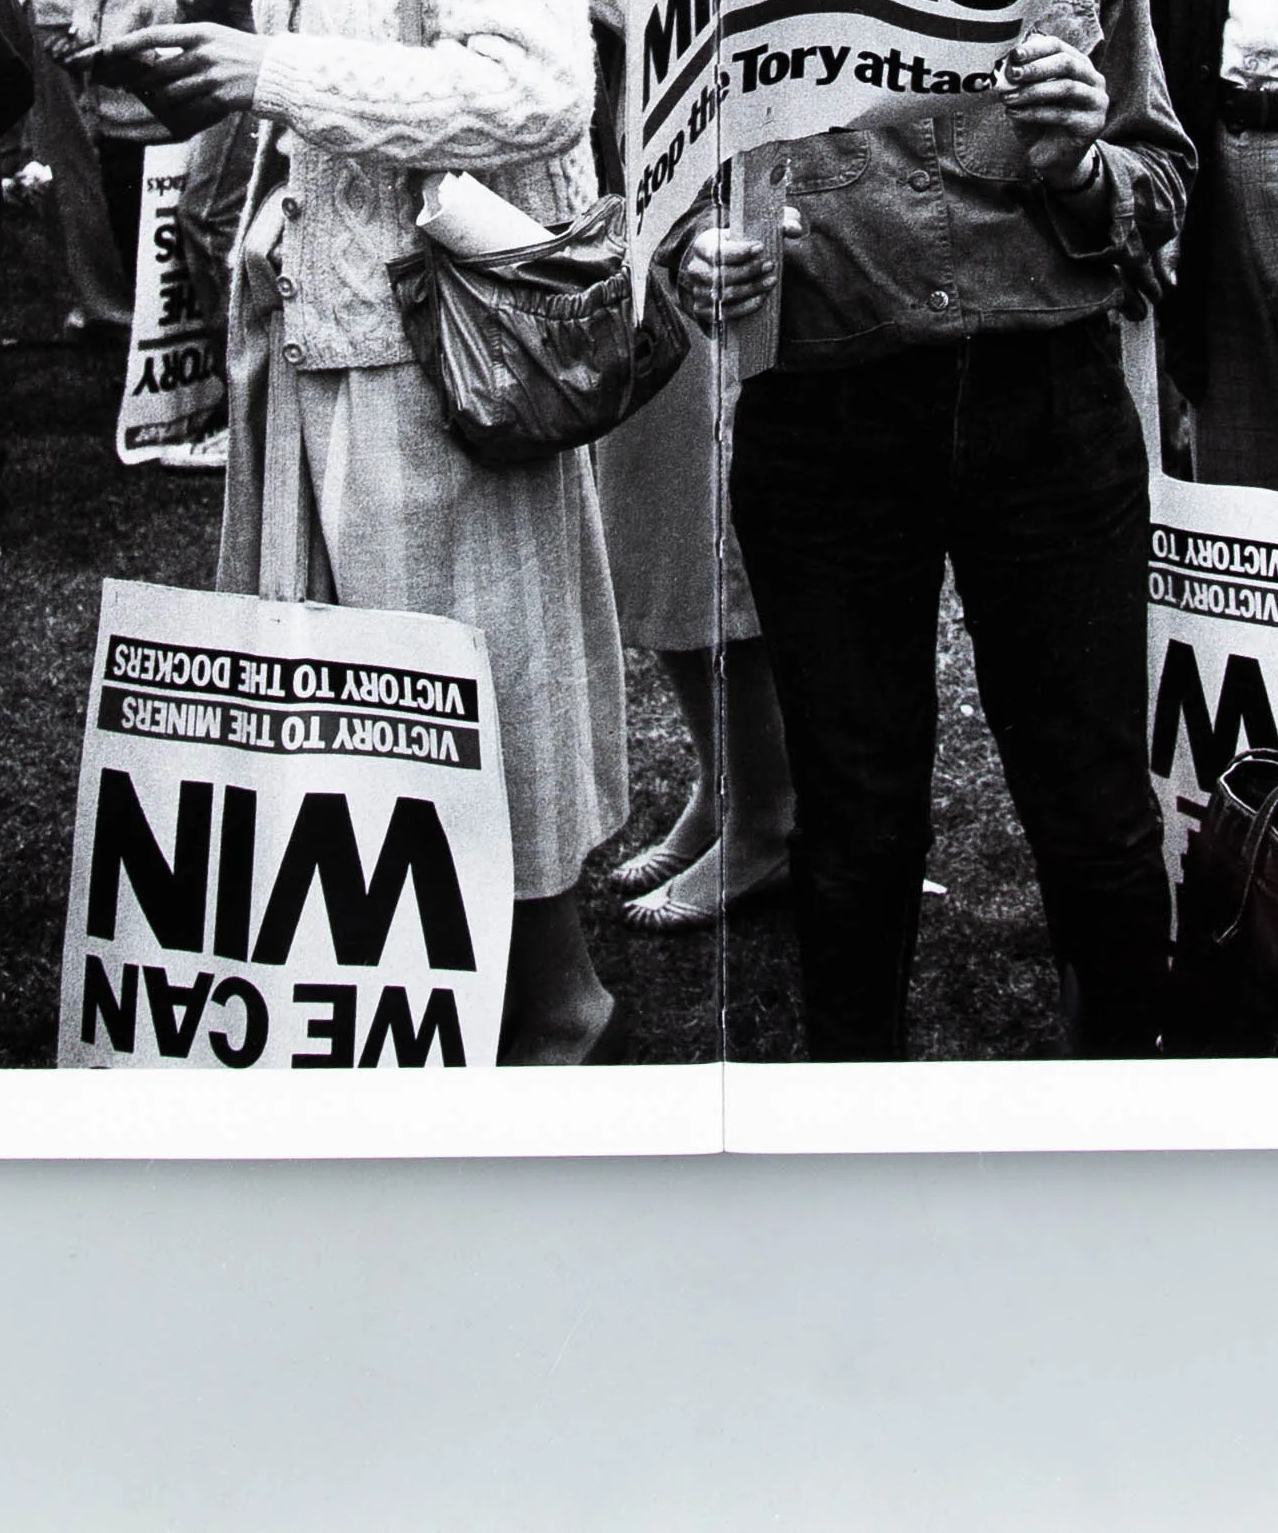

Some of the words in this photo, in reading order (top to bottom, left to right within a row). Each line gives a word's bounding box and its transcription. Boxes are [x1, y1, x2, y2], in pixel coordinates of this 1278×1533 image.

[687, 70, 730, 145] the
[732, 44, 850, 95] Tory
[1152, 529, 1179, 562] TO
[1149, 571, 1177, 605] TO
[113, 642, 230, 689] DOCKERS
[238, 659, 286, 698] THE
[292, 664, 335, 699] TO
[121, 694, 221, 739] MINERS
[340, 675, 465, 716] VICTORY
[228, 709, 275, 748] THE
[281, 715, 325, 750] TO
[332, 718, 460, 763] VICTORY
[87, 767, 477, 973] WIN
[81, 954, 270, 1069] CAN
[290, 984, 467, 1069] WE
